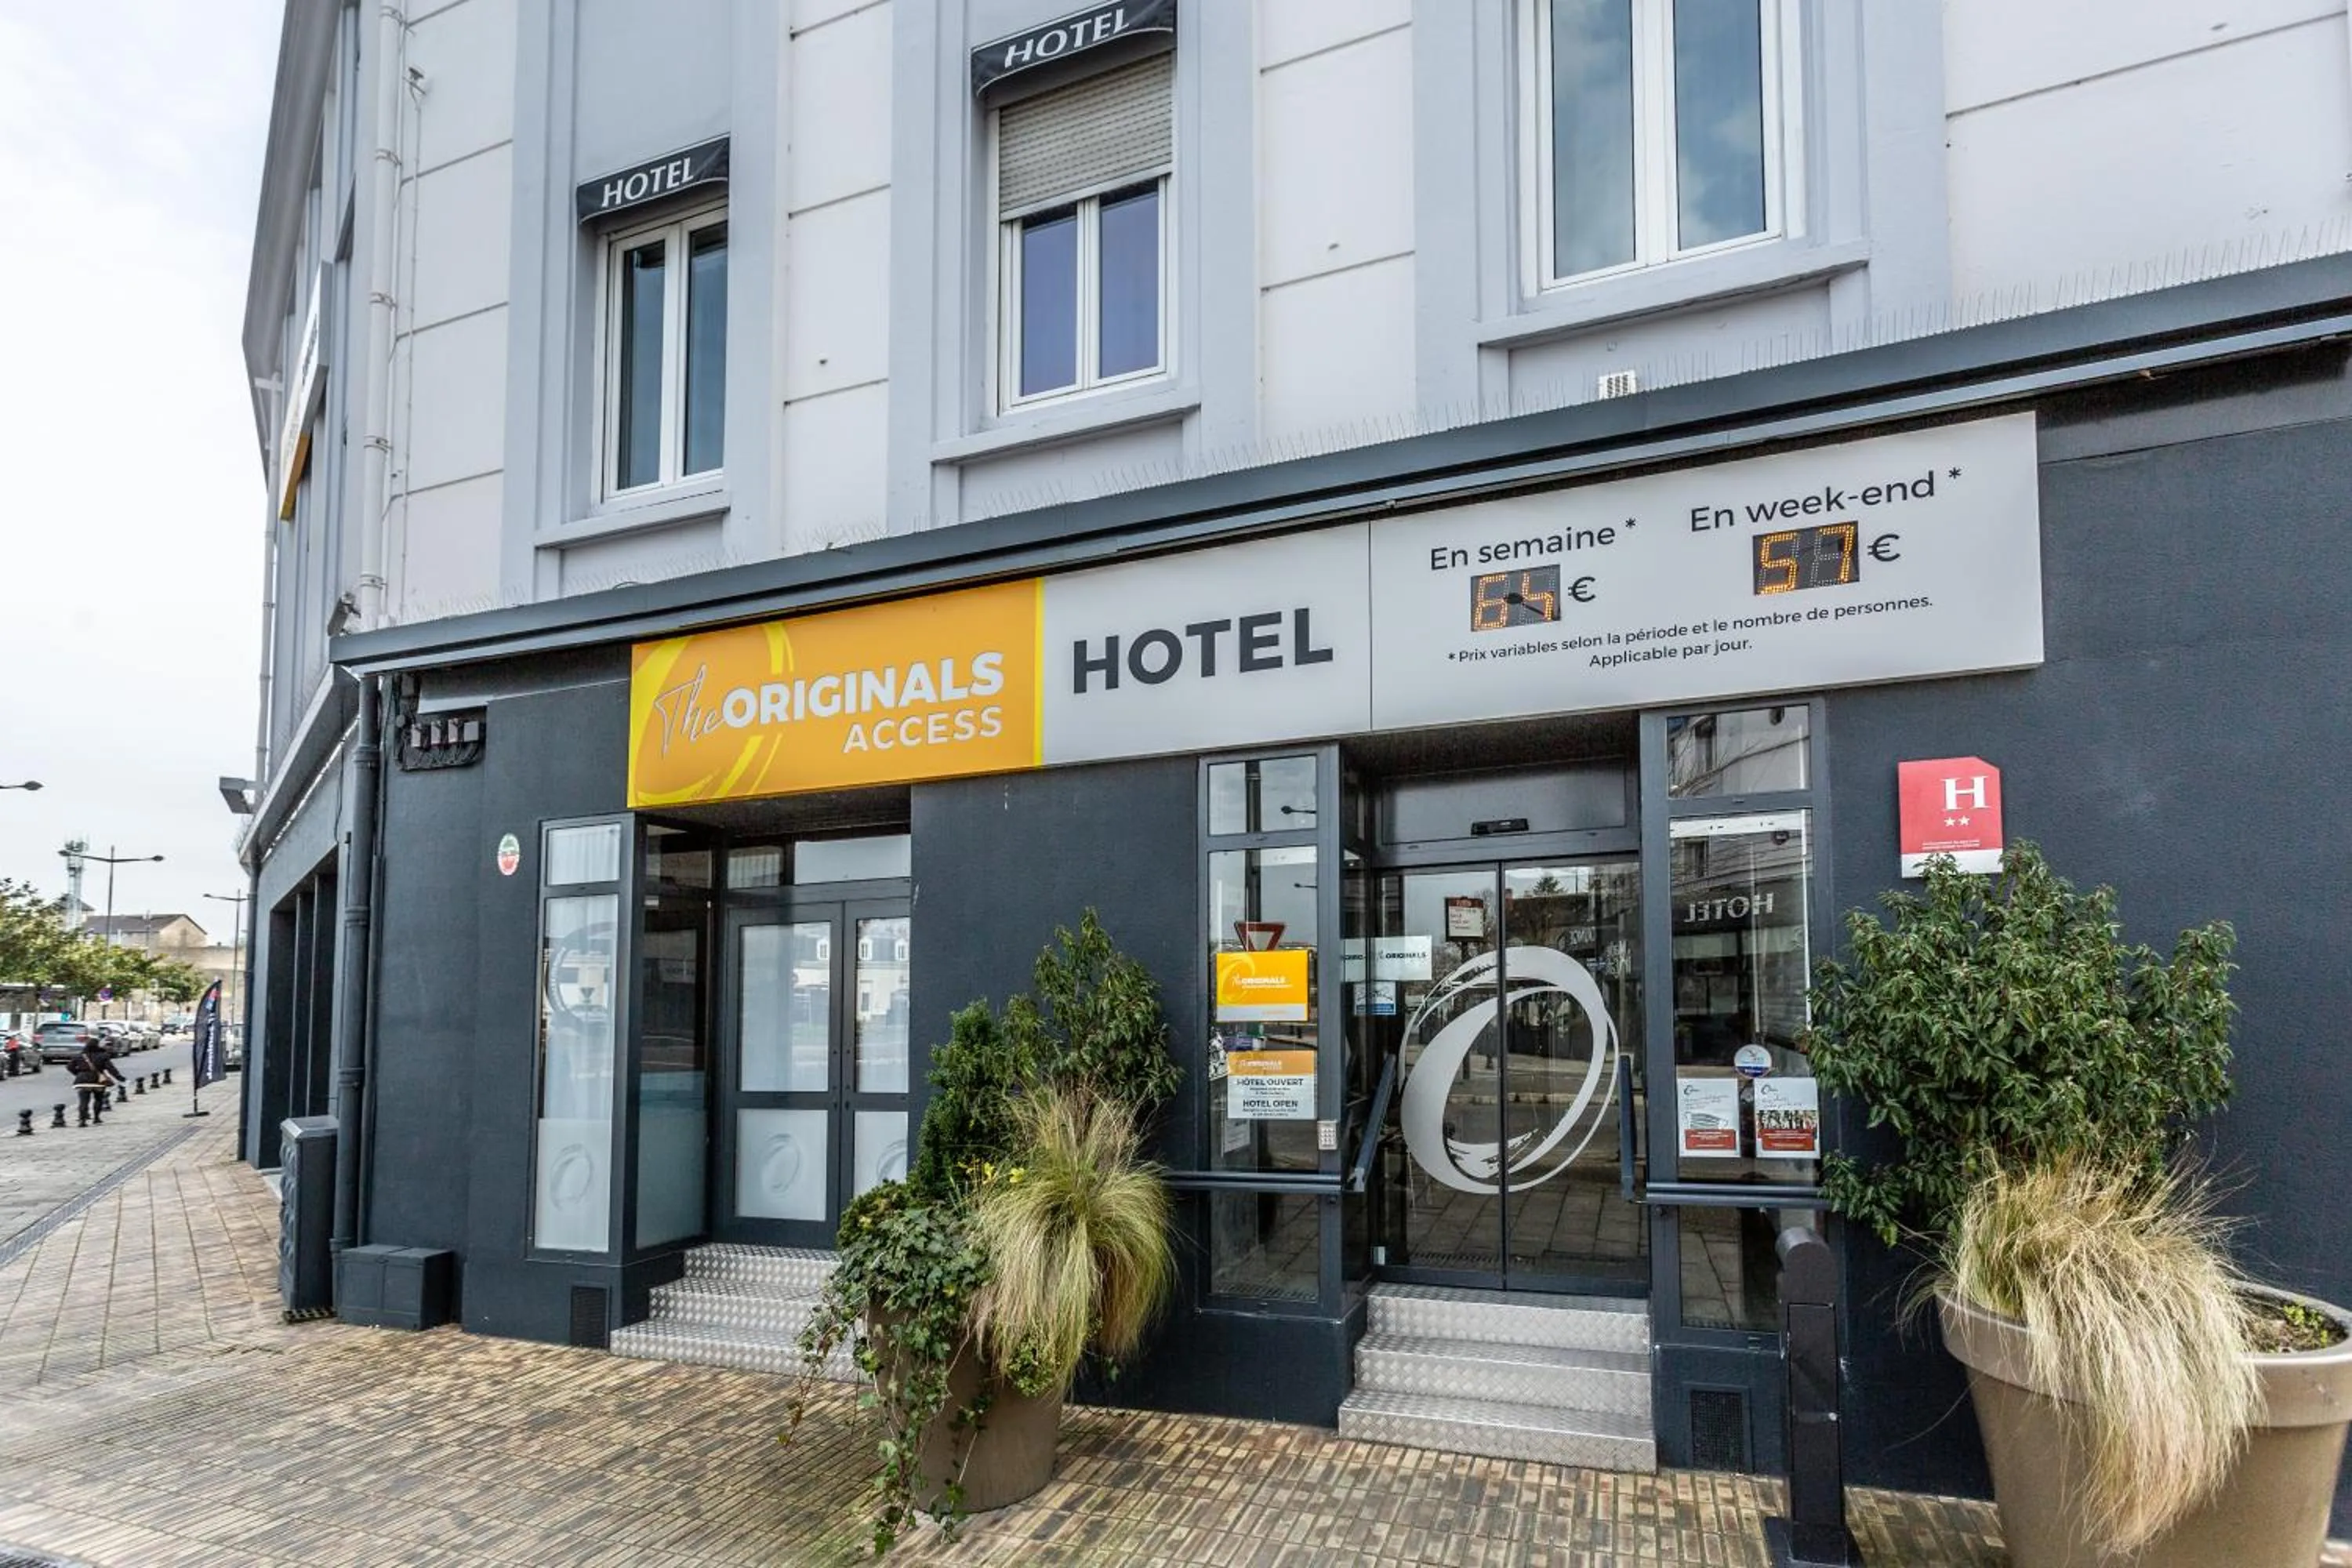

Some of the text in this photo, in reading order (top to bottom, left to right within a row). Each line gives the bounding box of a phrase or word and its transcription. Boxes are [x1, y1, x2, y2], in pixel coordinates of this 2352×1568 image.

[1004, 8, 1131, 69] HOTEL
[601, 157, 695, 209] HOTEL
[1690, 506, 1734, 532] En
[1746, 470, 1936, 524] week-end
[1430, 547, 1468, 571] En
[1478, 525, 1617, 564] semaine
[1759, 524, 1855, 596] 57
[1073, 607, 1334, 695] HOTEL
[1490, 641, 1558, 659] variables
[1561, 636, 1602, 649] selon
[1607, 633, 1621, 645] la
[1625, 623, 1688, 645] période
[1692, 622, 1709, 634] et
[1712, 619, 1729, 632] le
[1733, 612, 1802, 630] nombre
[1806, 608, 1829, 621] de
[1834, 596, 1934, 620] personnes.
[1588, 639, 1753, 668] Applicable par jour.
[654, 652, 1005, 760] The ORIGINALS
[842, 706, 1003, 753] ACCESS
[1940, 775, 1991, 813] H
